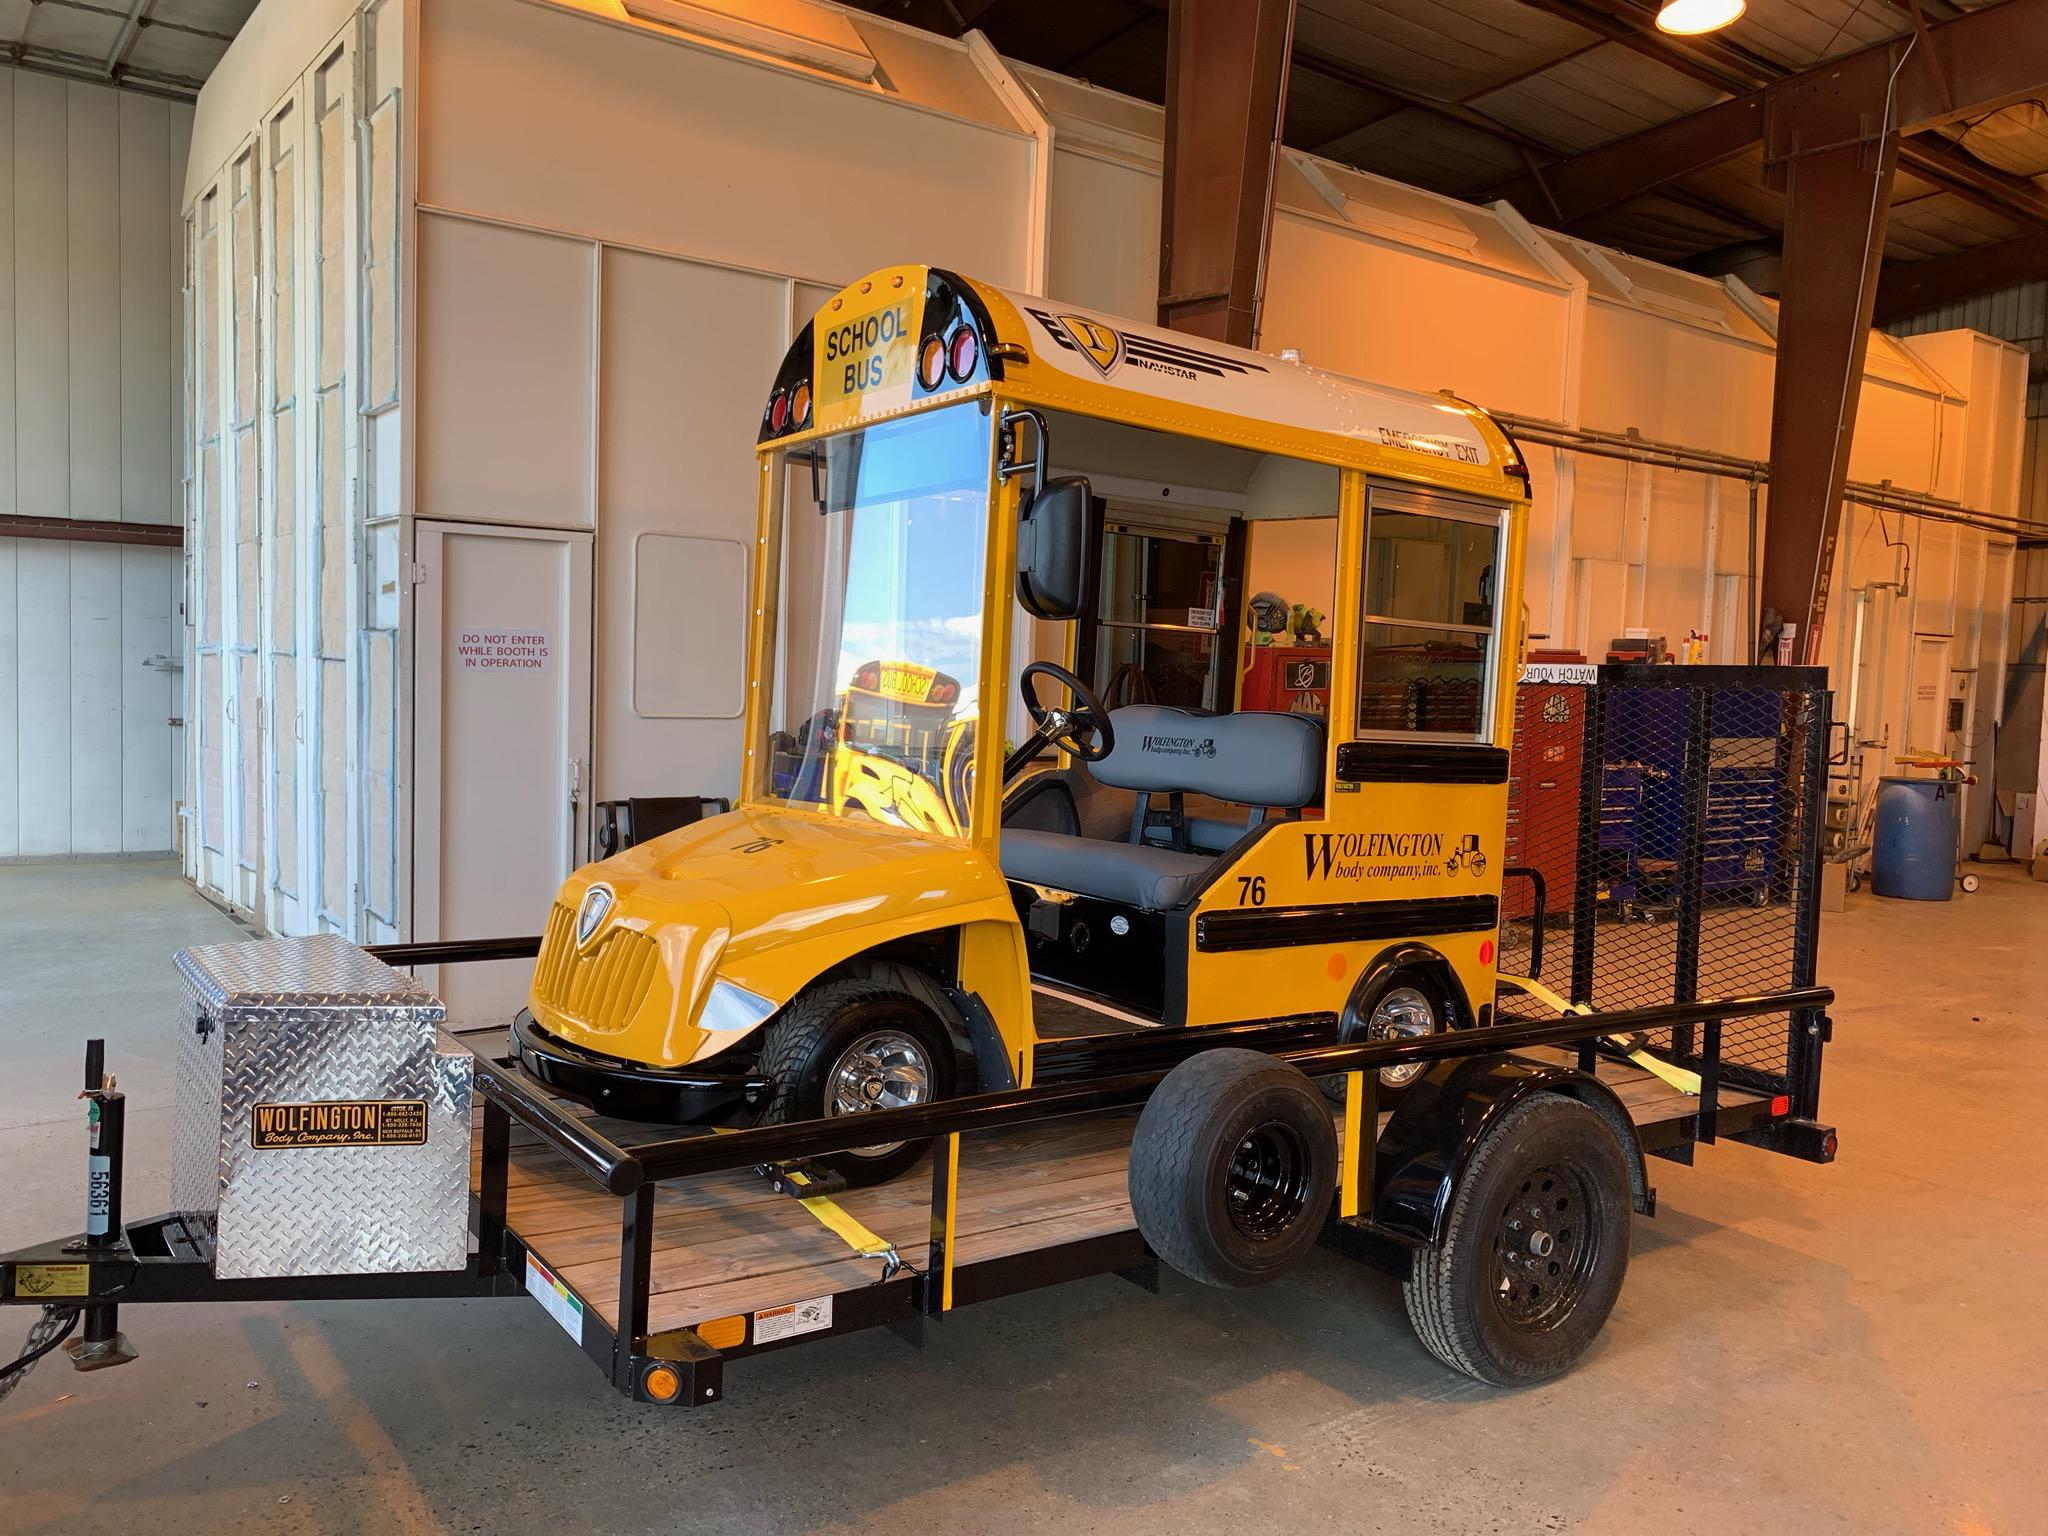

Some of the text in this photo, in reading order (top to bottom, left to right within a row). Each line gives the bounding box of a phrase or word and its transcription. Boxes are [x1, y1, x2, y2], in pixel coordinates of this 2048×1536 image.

[827, 307, 907, 362] SCHOOL
[844, 354, 883, 394] BUS
[1138, 359, 1197, 381] NAVISTAR
[1379, 427, 1479, 464] EMERGENCY EXIT
[1817, 536, 1834, 612] FIRE
[462, 634, 545, 645] DO NOT ENTER
[458, 646, 549, 657] WHILE BOOTH IS
[465, 658, 542, 668] IN OPERATION
[1526, 667, 1555, 680] YOUR
[1558, 668, 1597, 681] WATCH
[1141, 735, 1196, 753] WOLFINGTON
[730, 836, 785, 854] 76
[1304, 832, 1444, 882] WOLFINGTON
[1335, 861, 1364, 882] body
[1237, 876, 1266, 906] 76
[259, 1105, 376, 1132] WOLFINGTON
[264, 1130, 374, 1144] Body Company, Inc.
[90, 1171, 110, 1216] 56361
[764, 1307, 791, 1318] WARNING
